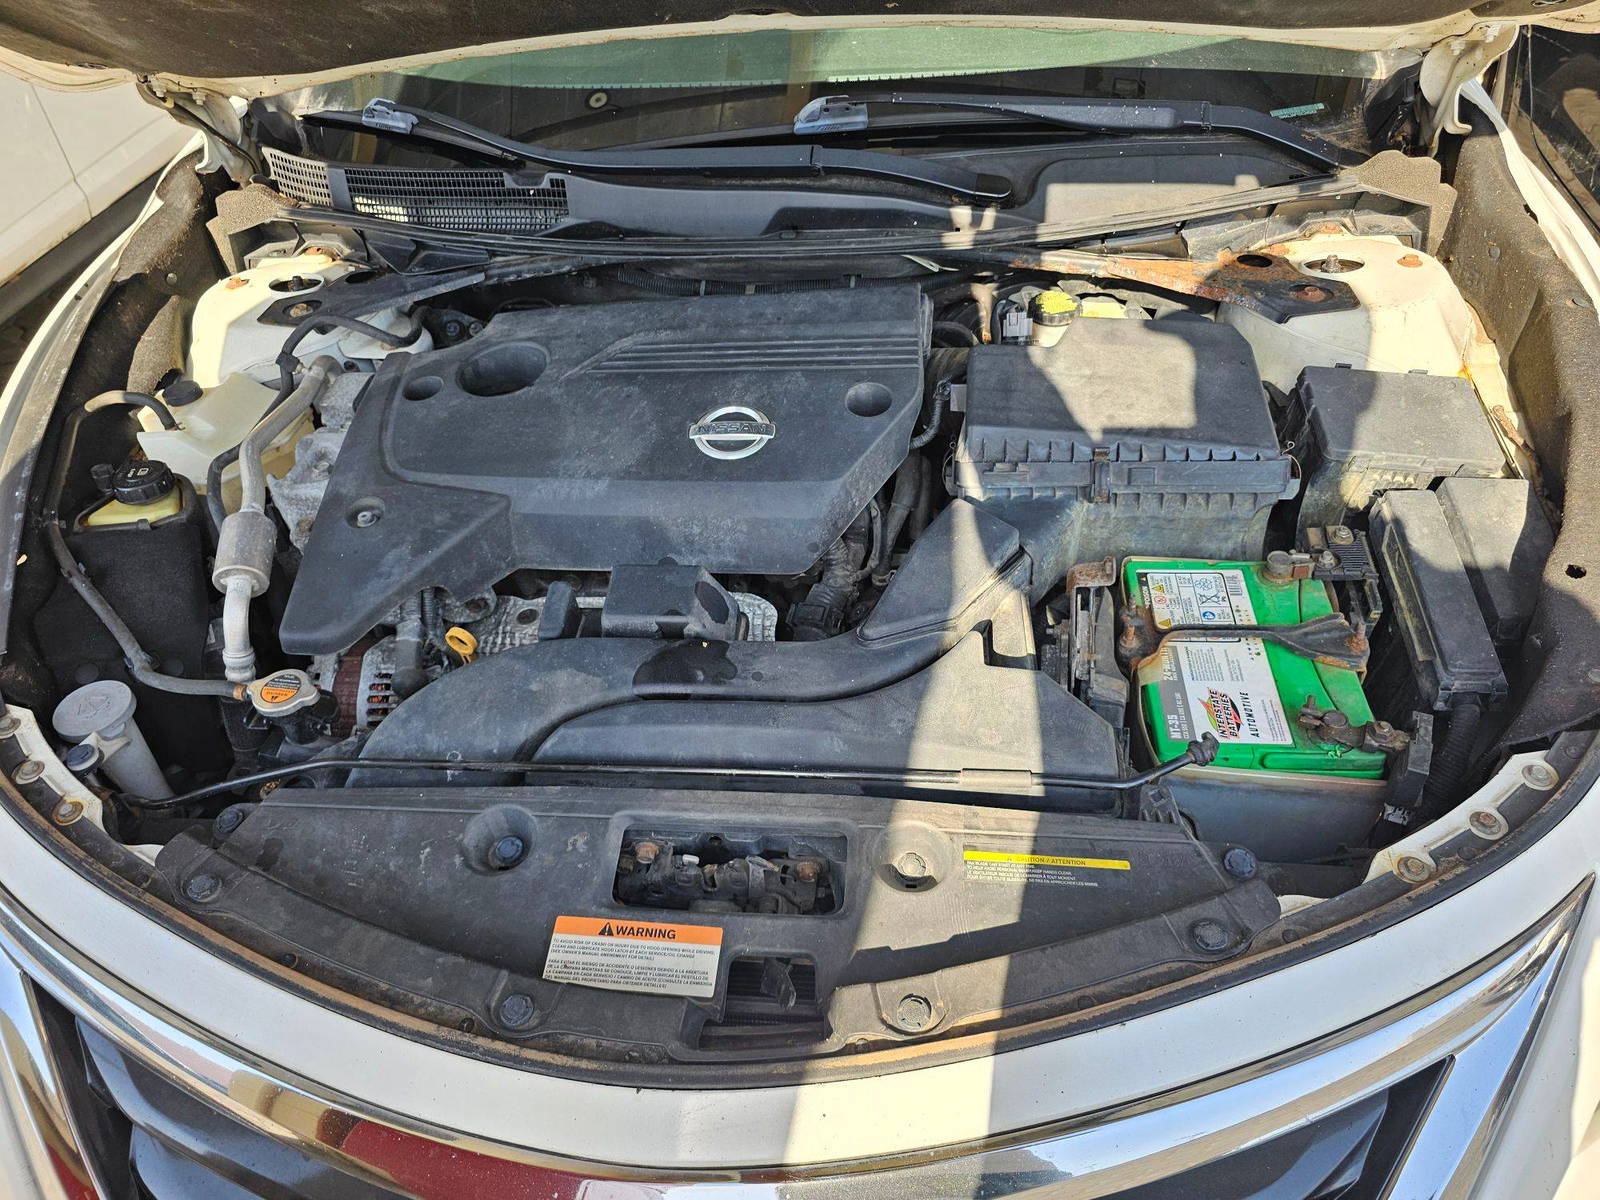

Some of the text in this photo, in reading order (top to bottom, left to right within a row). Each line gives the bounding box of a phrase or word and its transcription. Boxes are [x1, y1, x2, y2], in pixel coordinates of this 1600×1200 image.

[698, 423, 766, 433] NISSAN
[1167, 714, 1182, 739] MT-35
[1209, 689, 1228, 738] INTERSTATE
[1220, 692, 1238, 737] BATTERIES
[1239, 691, 1260, 738] AUTOMOTIVE
[616, 925, 676, 939] WARNING
